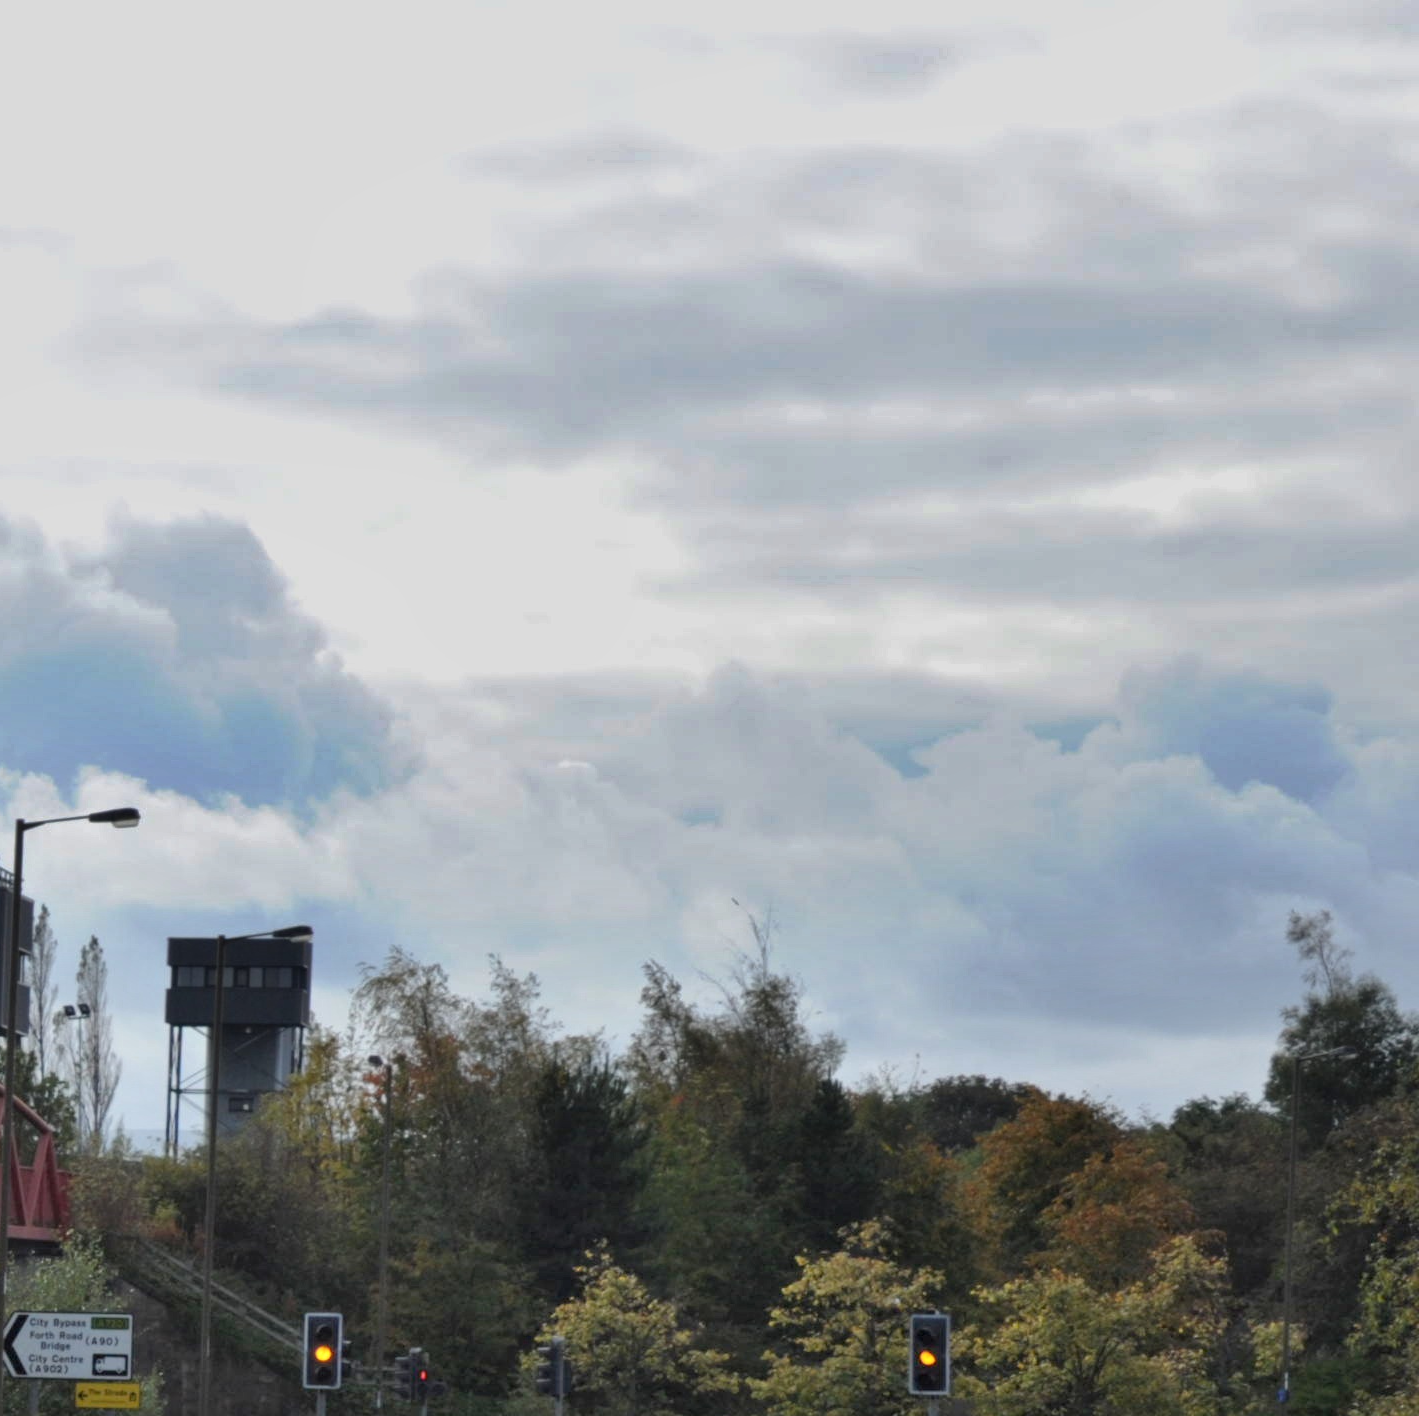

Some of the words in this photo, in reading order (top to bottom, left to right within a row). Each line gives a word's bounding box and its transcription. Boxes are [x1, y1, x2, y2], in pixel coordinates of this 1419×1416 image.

[30, 1318, 48, 1327] City
[54, 1319, 86, 1328] Bypass
[59, 1332, 83, 1340] Road
[41, 1341, 71, 1351] Bridge
[85, 1337, 119, 1346] (A90)
[28, 1355, 47, 1364] City
[52, 1355, 83, 1363] Centre
[29, 1365, 68, 1374] (A902)
